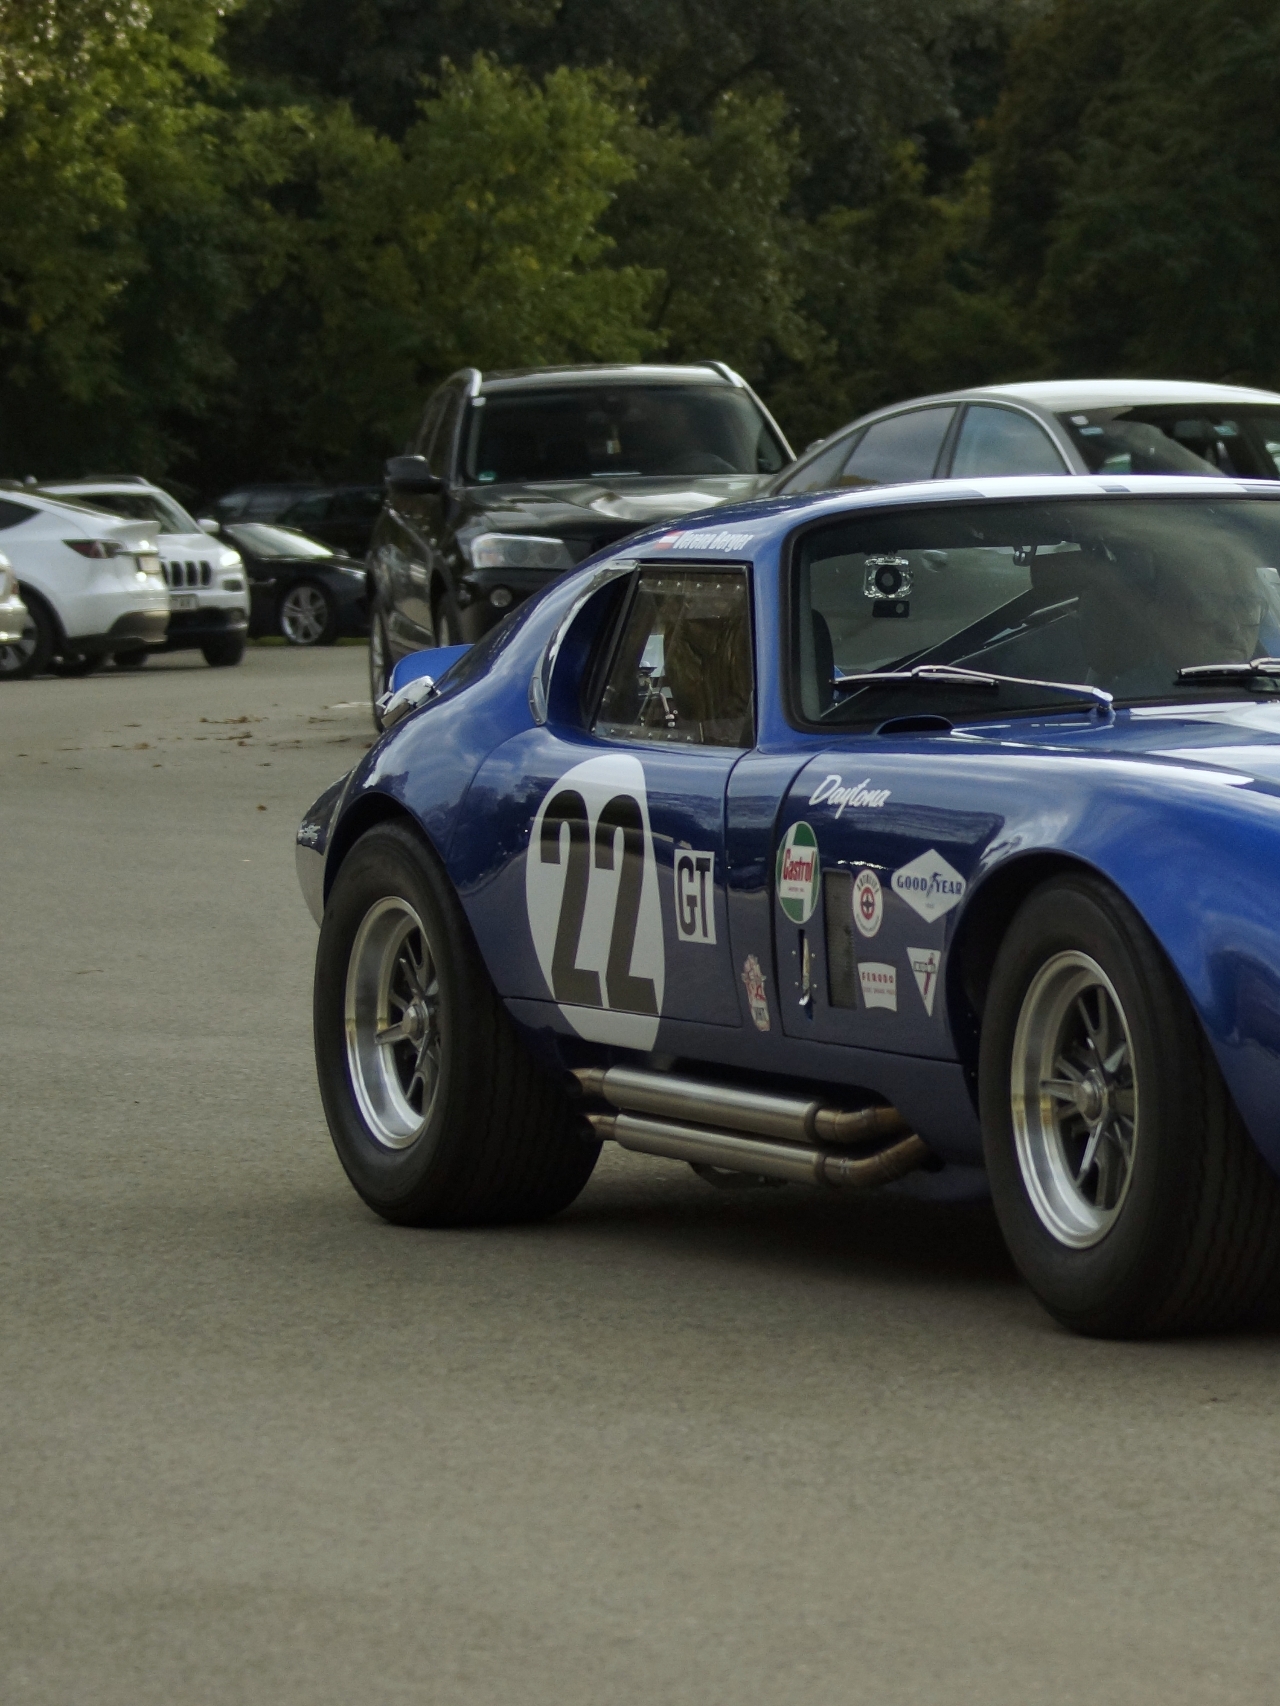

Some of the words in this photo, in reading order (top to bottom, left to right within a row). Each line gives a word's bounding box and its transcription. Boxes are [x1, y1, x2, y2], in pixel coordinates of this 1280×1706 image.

[708, 531, 754, 552] Berger
[808, 774, 892, 819] Daytona
[783, 848, 816, 882] Castrol
[540, 789, 659, 1016] 22
[677, 855, 711, 938] GT
